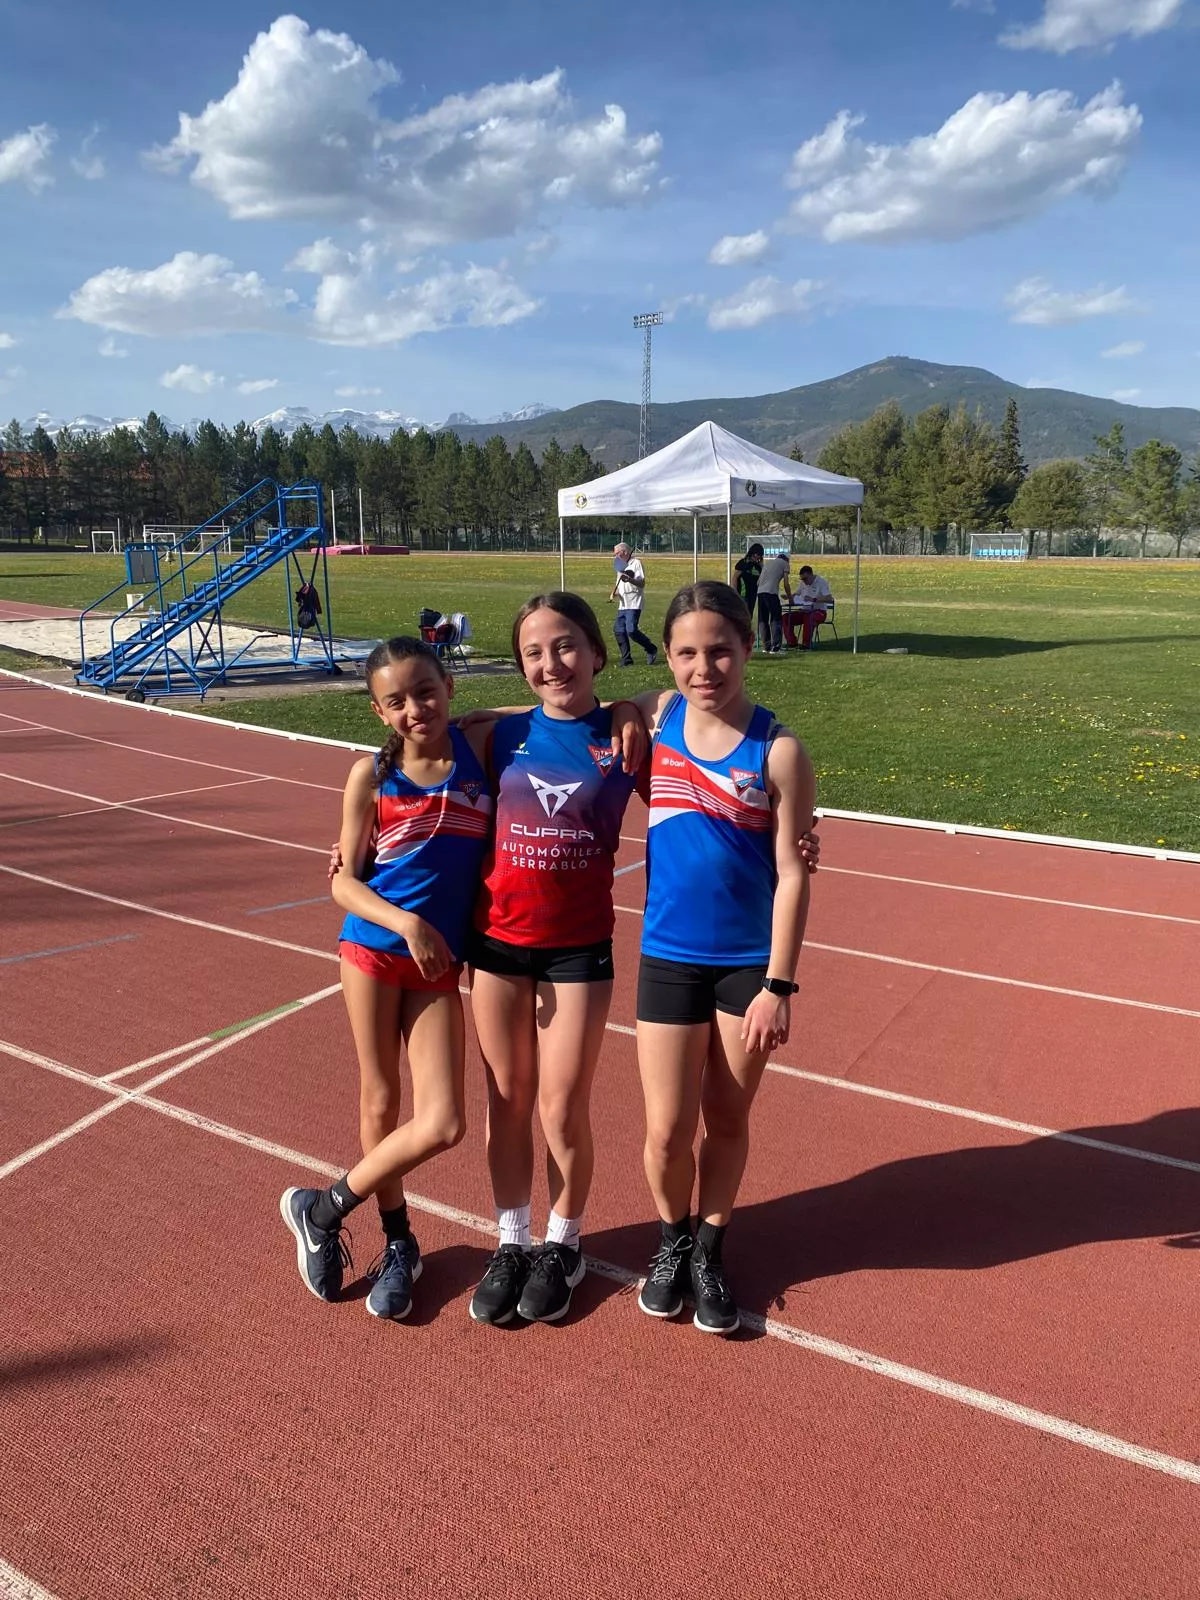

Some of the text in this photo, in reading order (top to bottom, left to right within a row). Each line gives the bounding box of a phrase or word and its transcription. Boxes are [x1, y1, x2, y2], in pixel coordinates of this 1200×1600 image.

[510, 823, 595, 841] CUPRA
[502, 841, 602, 858] AUTOMÓVILES
[512, 856, 588, 871] SERRABLO
